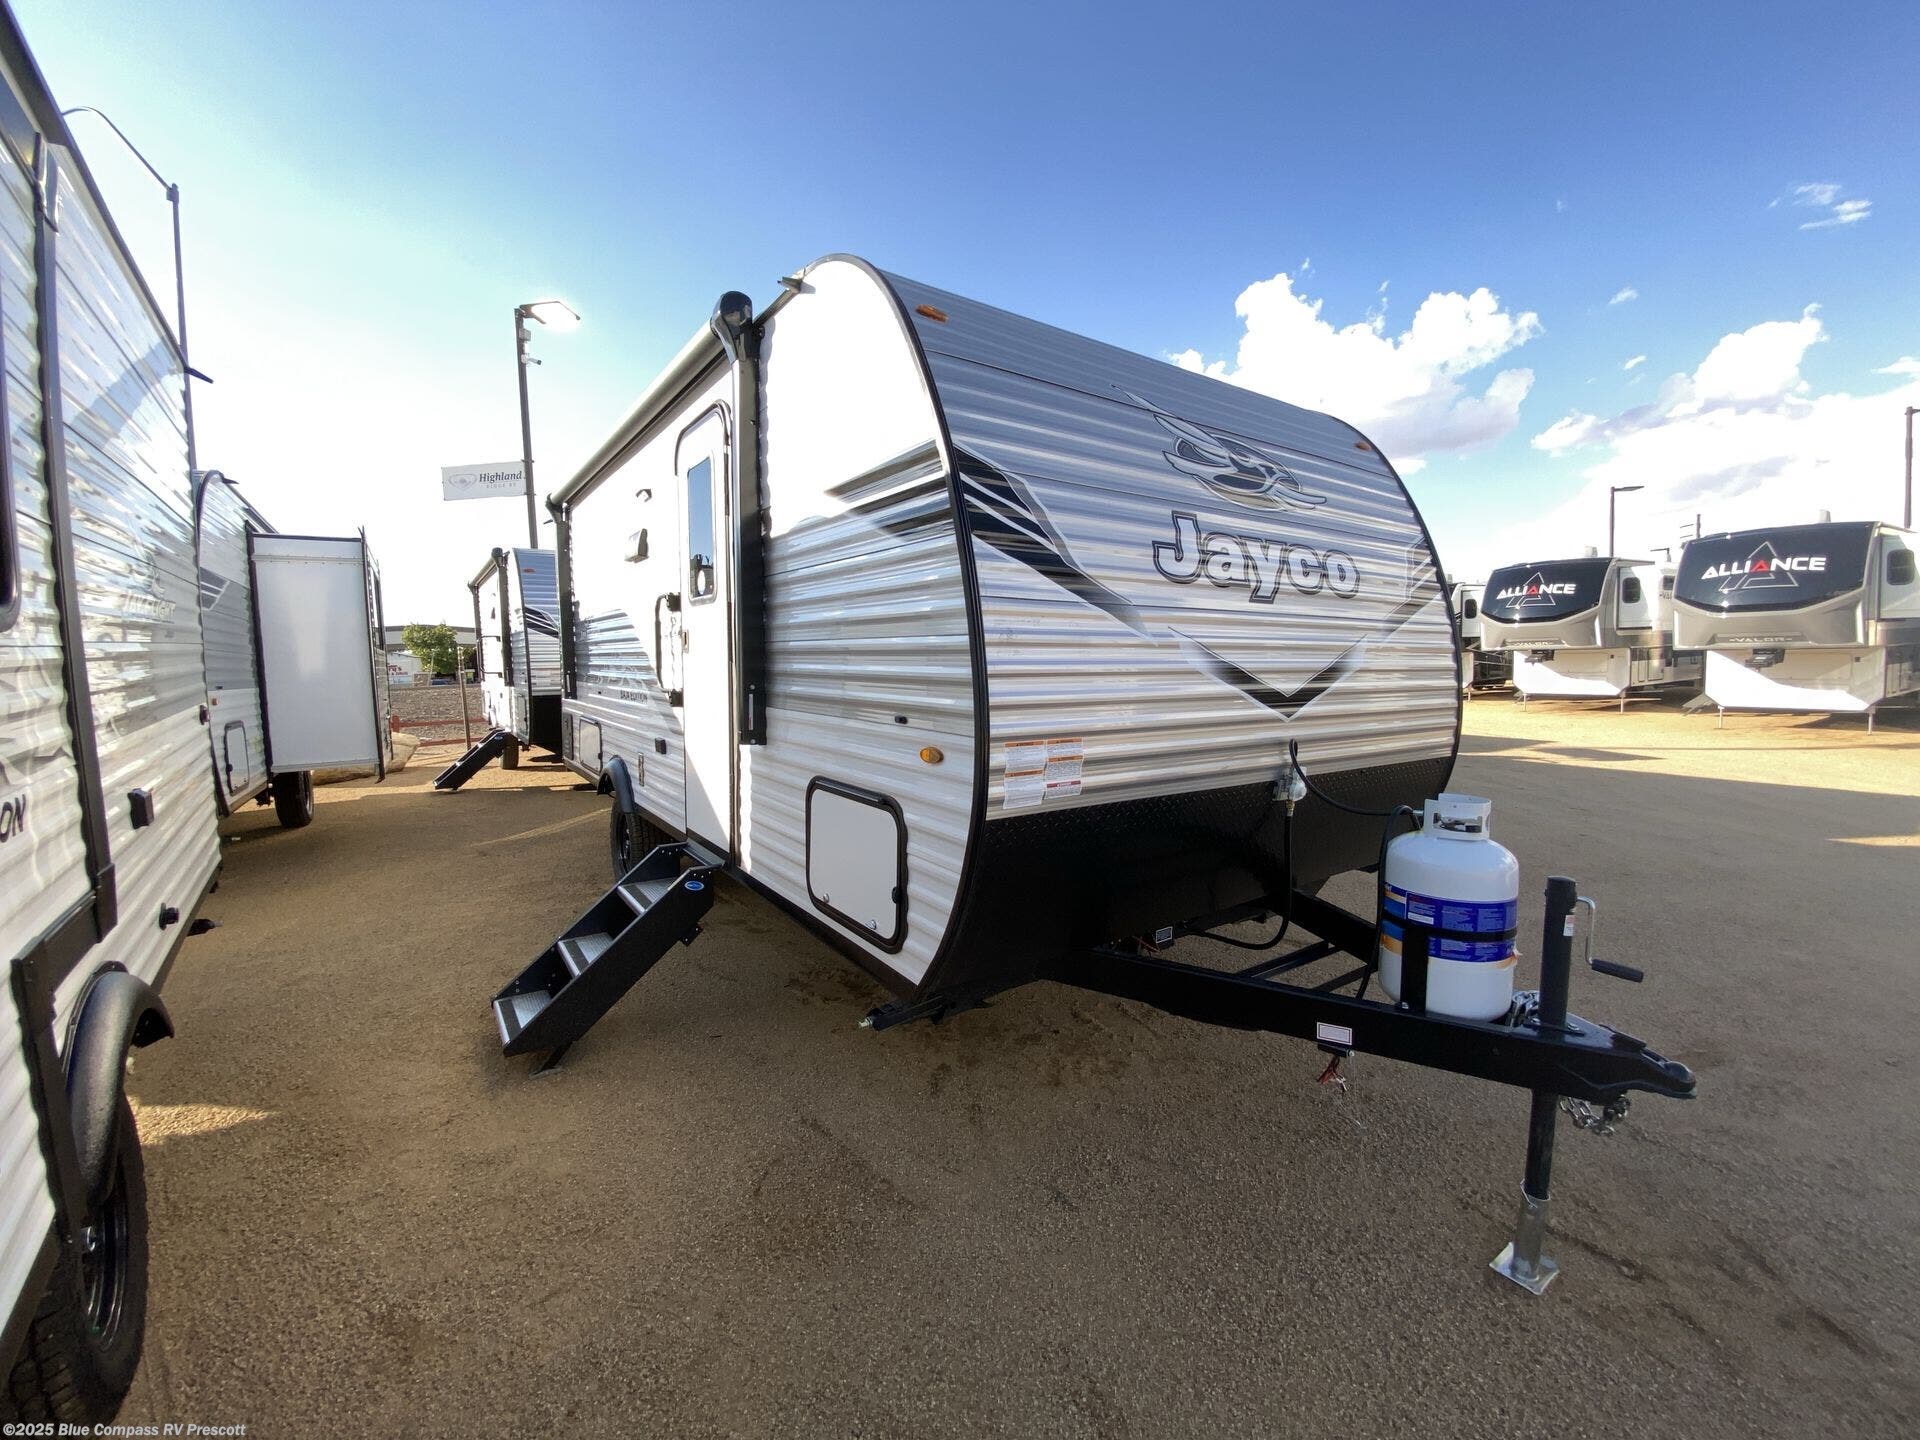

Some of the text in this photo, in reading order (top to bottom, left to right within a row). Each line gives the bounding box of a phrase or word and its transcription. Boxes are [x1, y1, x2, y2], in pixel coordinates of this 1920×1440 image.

[479, 471, 522, 483] Highland
[1151, 509, 1361, 604] Jayco
[1701, 557, 1827, 580] ALLIANCE
[1496, 583, 1577, 600] ALLIANCE
